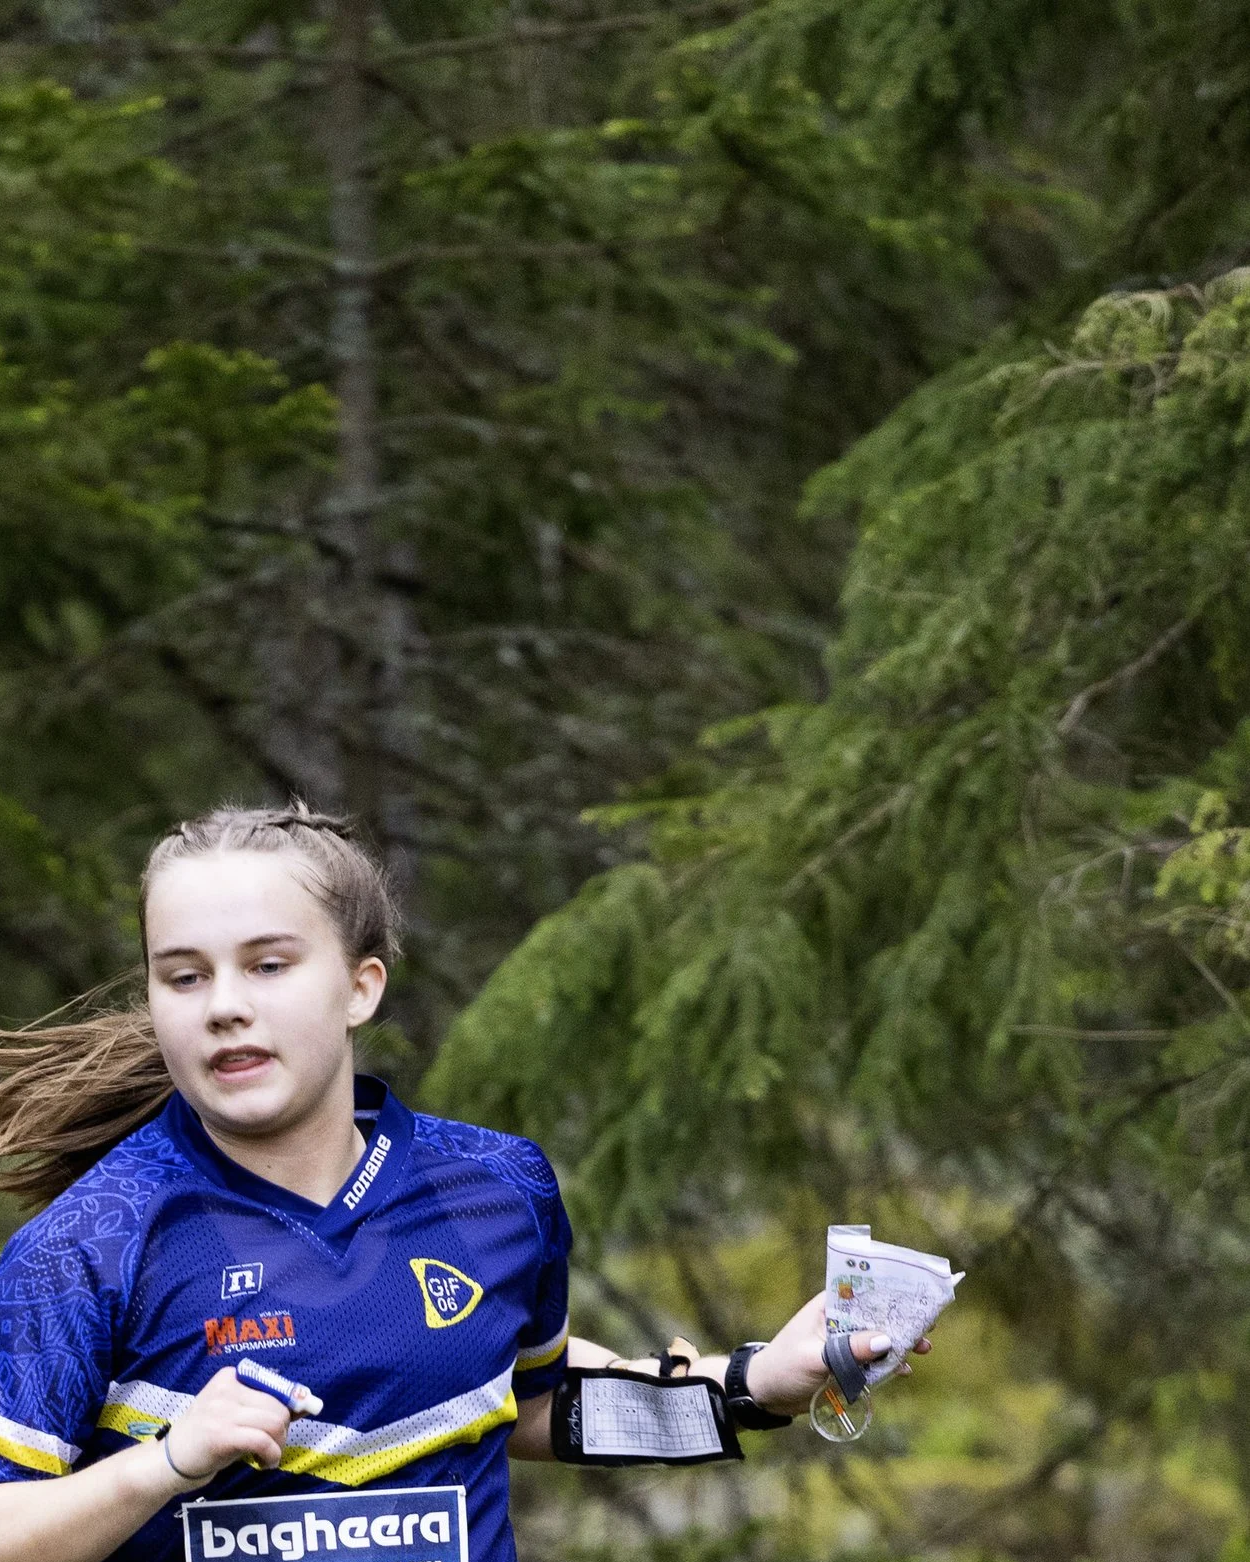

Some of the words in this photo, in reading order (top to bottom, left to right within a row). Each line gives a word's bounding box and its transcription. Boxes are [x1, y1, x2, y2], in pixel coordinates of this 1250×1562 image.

[343, 1134, 392, 1211] noname
[427, 1277, 460, 1297] GIF
[437, 1297, 458, 1312] 06
[205, 1315, 295, 1347] MAXI
[201, 1511, 451, 1561] bagheera
